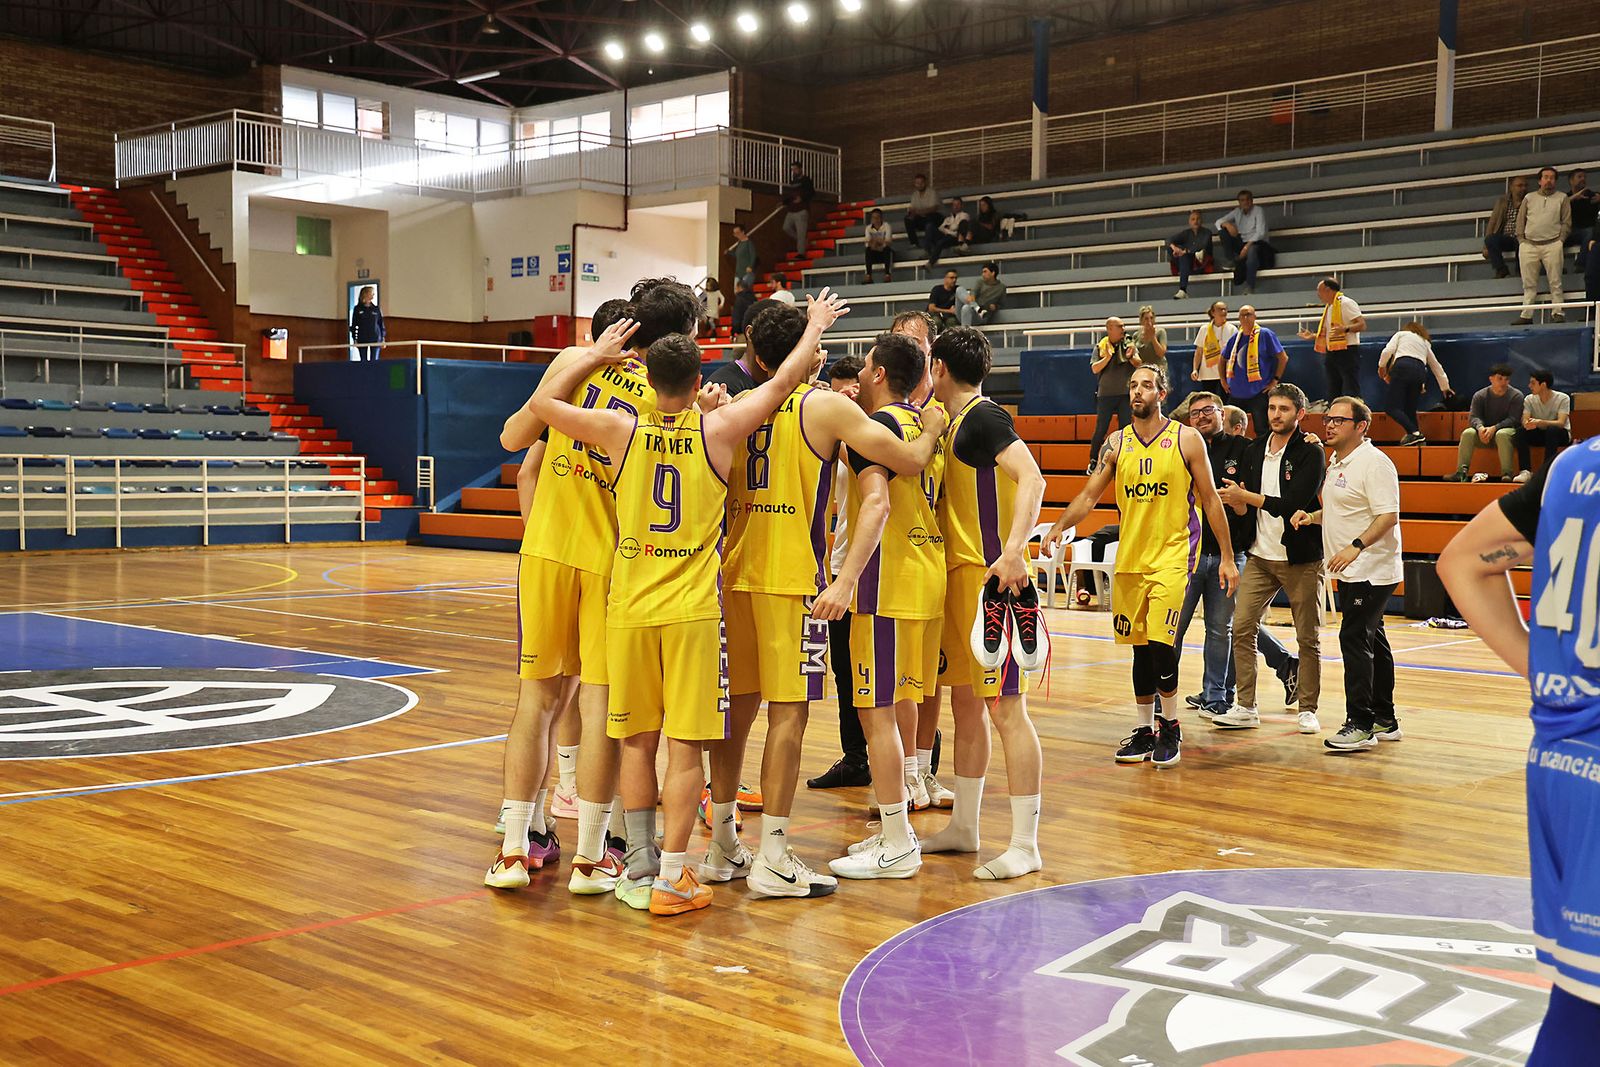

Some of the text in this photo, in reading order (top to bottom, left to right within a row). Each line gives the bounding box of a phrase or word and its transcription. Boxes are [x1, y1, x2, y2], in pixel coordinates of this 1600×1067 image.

[601, 365, 647, 397] HOMS
[644, 433, 694, 455] TRVER
[746, 423, 774, 491] 8
[1139, 457, 1153, 476] 10
[649, 463, 683, 533] 9
[744, 502, 796, 515] Rmauto
[1165, 608, 1179, 627] 10
[858, 663, 870, 684] 4
